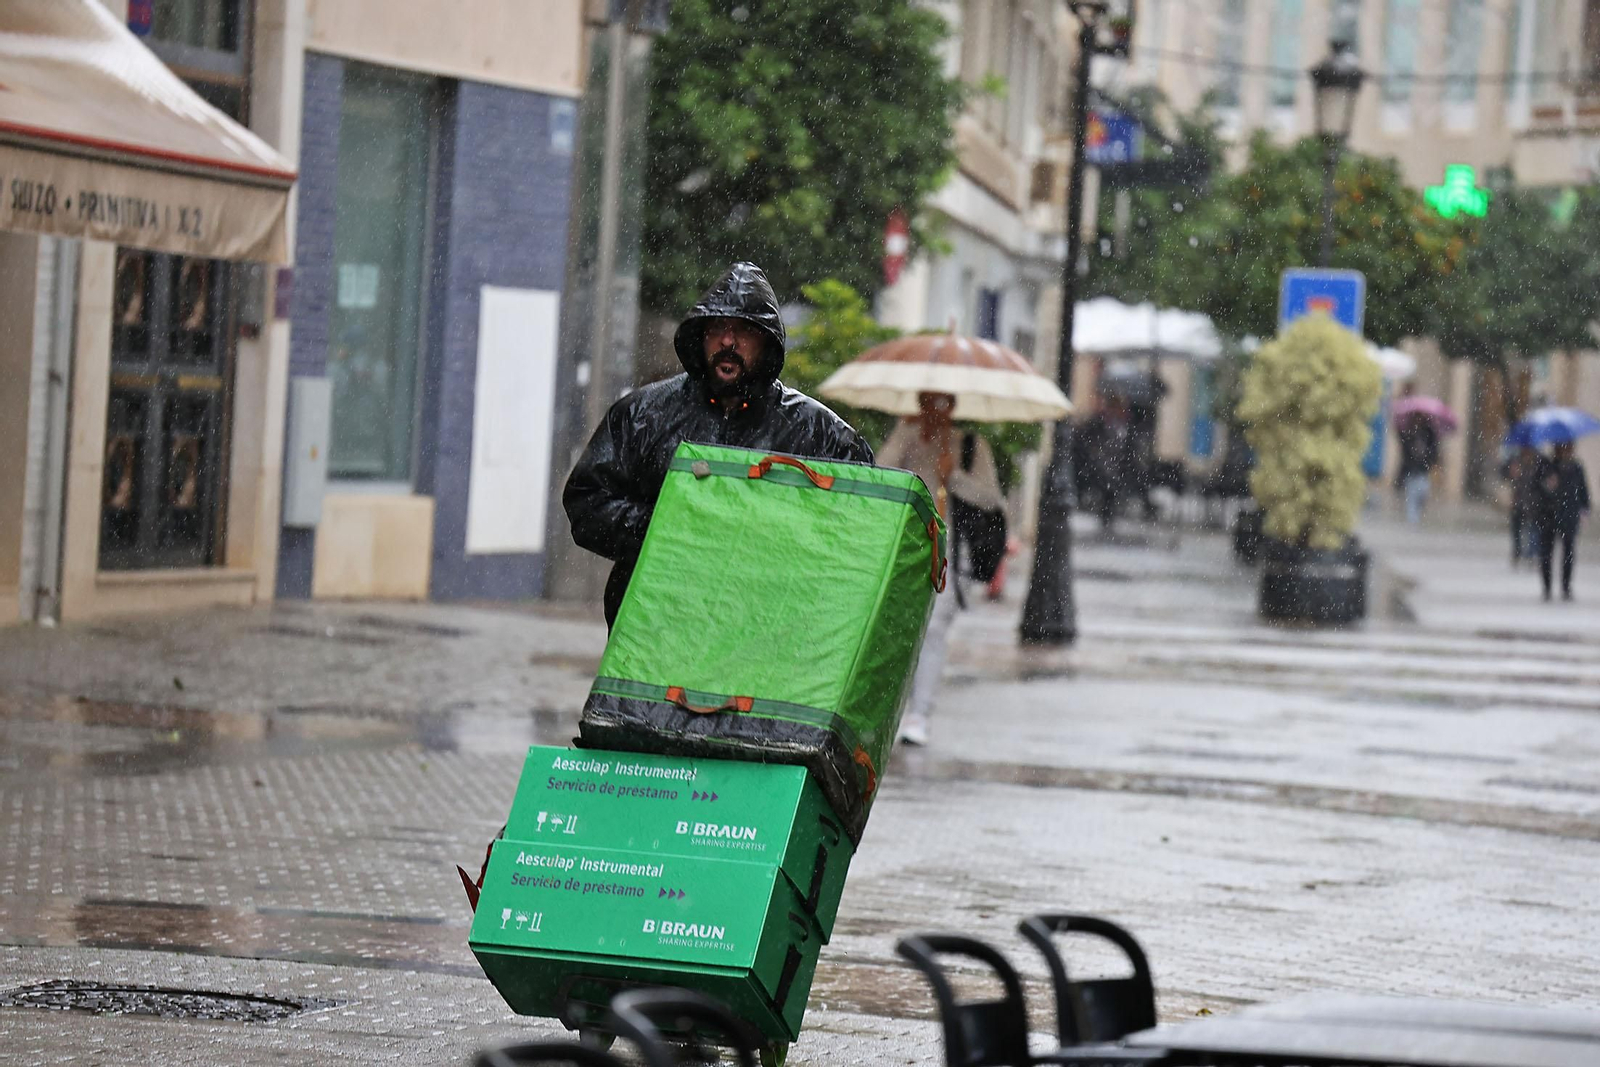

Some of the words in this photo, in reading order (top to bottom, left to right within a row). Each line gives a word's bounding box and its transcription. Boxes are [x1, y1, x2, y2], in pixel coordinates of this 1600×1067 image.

[614, 761, 698, 781] Instrumental
[546, 776, 596, 793] Servicio
[599, 780, 615, 795] de
[690, 837, 726, 849] SHARING
[726, 840, 767, 852] EXPERTISE
[579, 856, 665, 878] Instrumental
[510, 872, 561, 890] Servicio
[564, 877, 581, 892] de
[657, 936, 693, 948] SHARING
[694, 939, 736, 952] EXPERTISE
